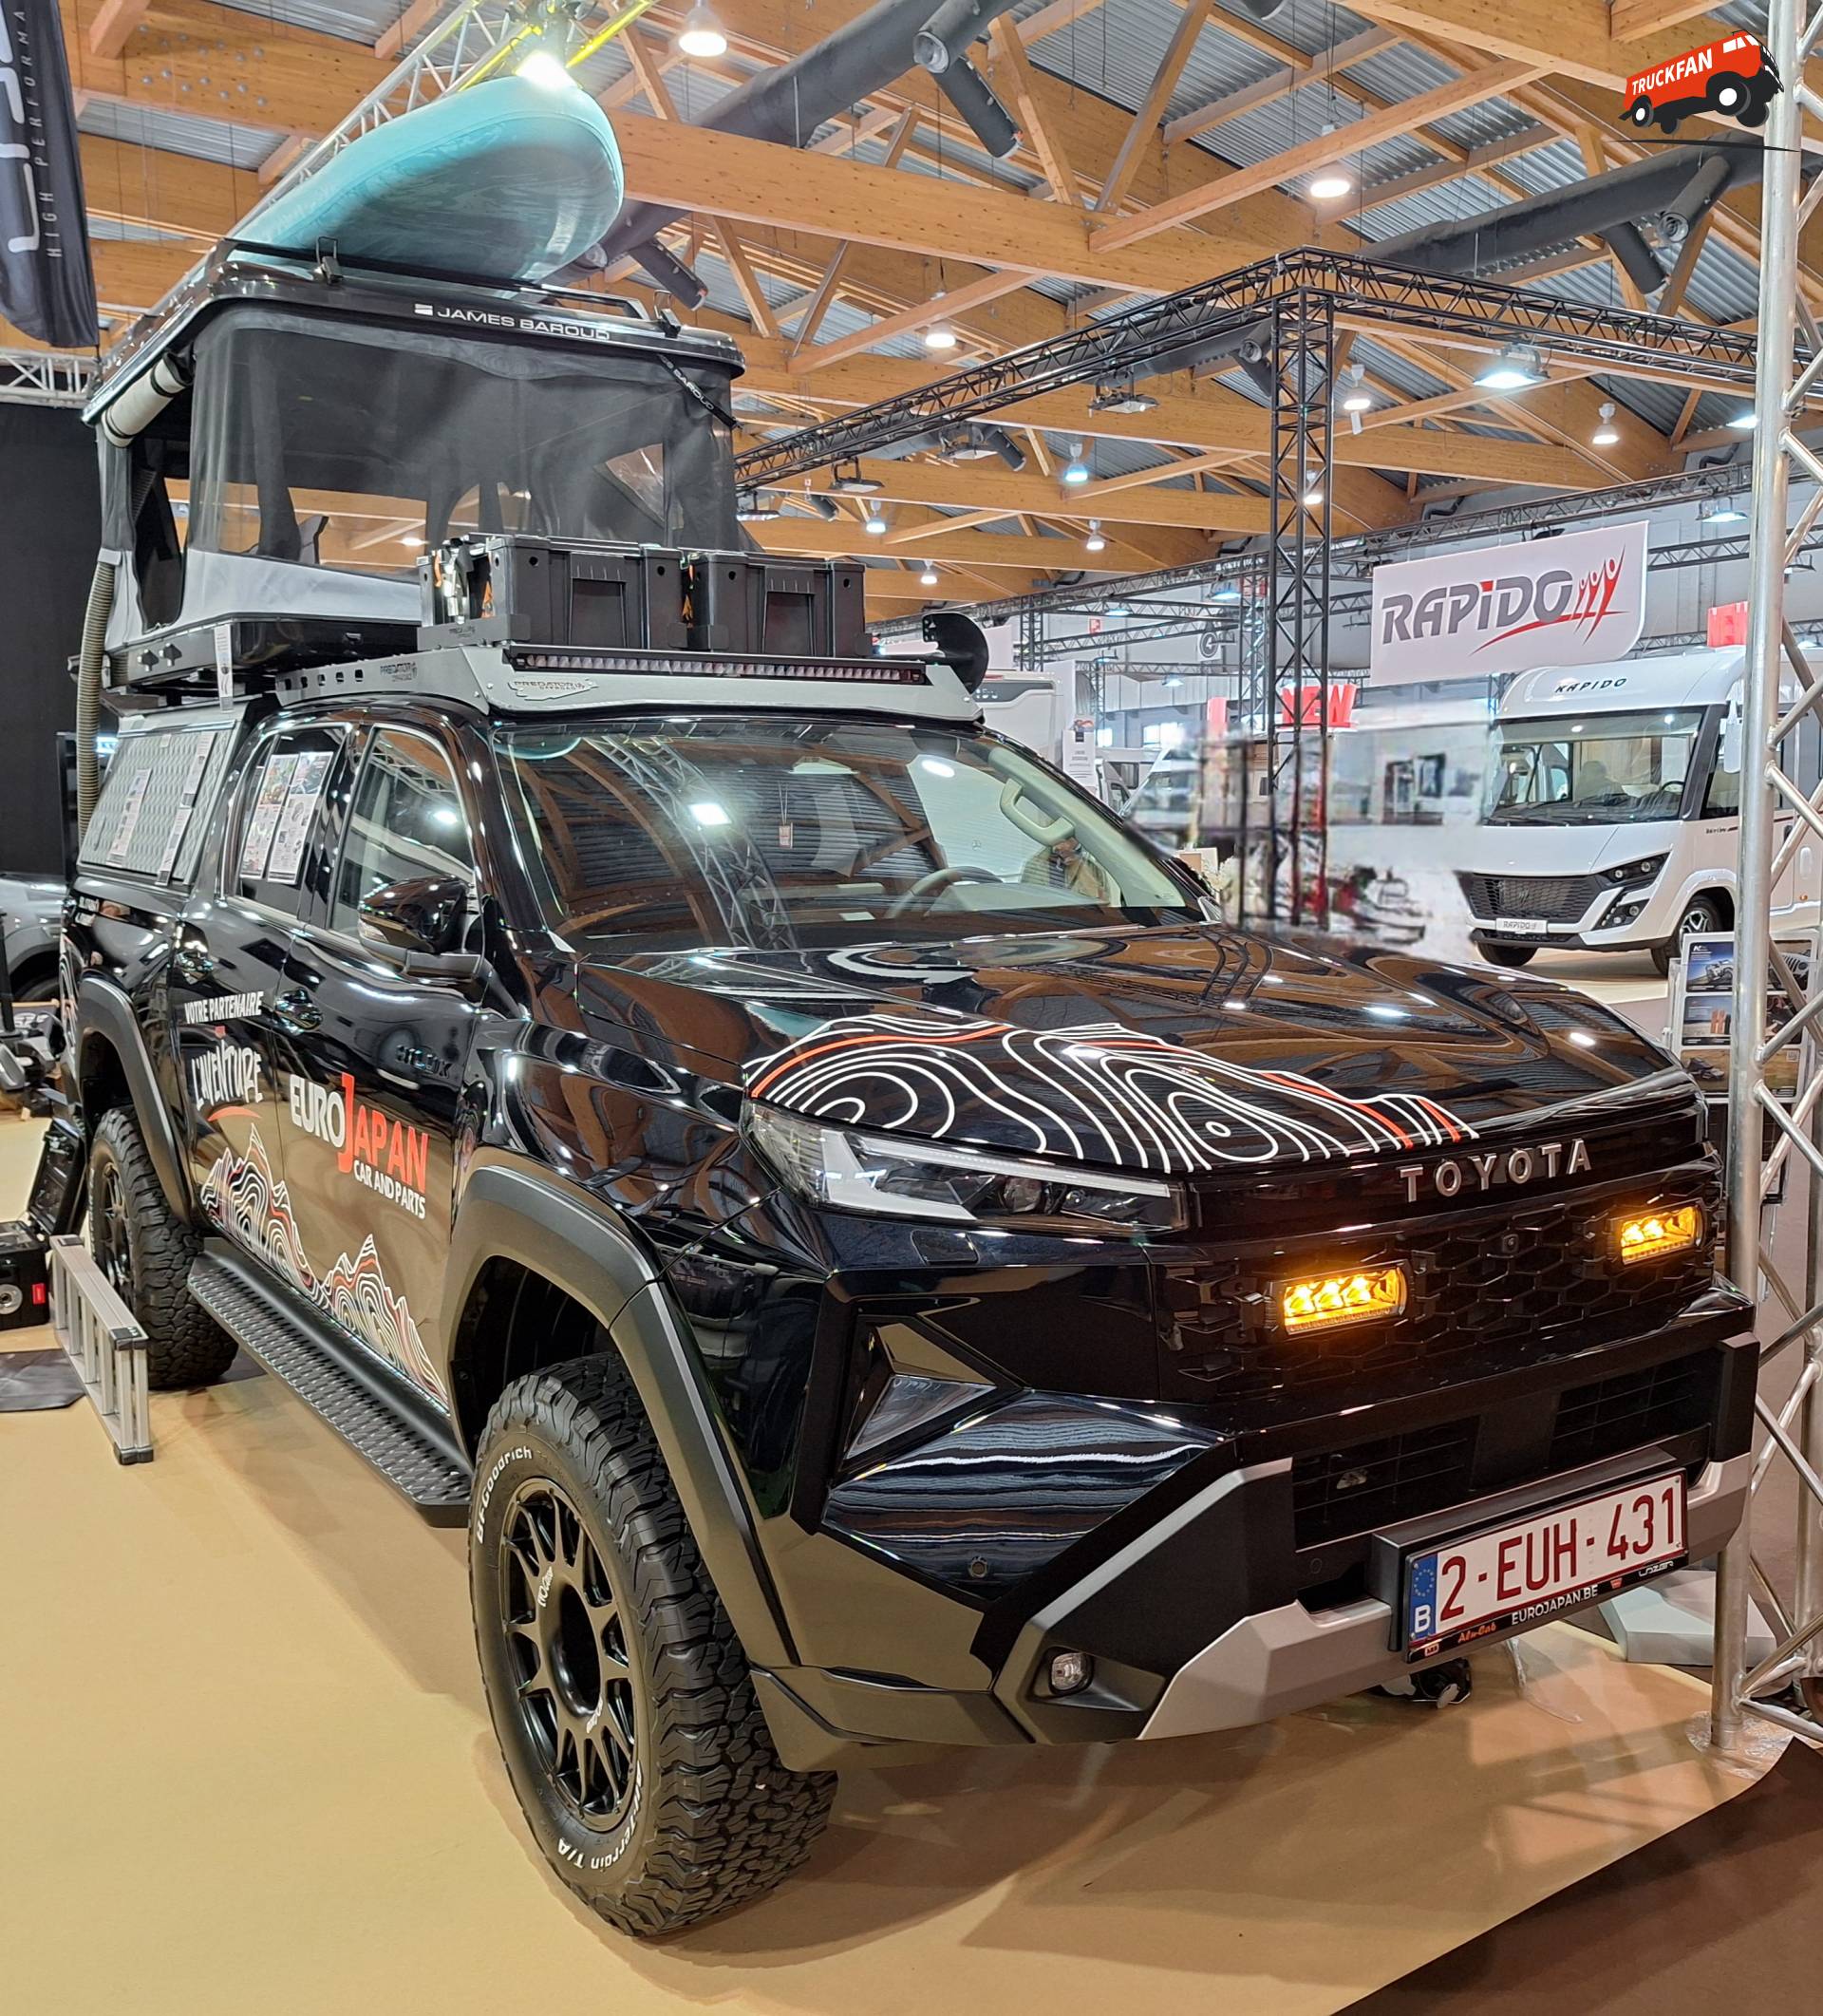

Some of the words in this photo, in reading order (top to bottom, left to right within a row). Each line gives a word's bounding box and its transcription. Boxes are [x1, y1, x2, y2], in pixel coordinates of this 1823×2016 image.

[39, 191, 63, 258] HIGH
[437, 308, 516, 328] JAMES
[519, 319, 611, 341] BAROUD
[184, 999, 209, 1025] VOTRE
[209, 990, 264, 1022] PARTENAIRE
[290, 1071, 430, 1194] EUROJAPAN
[353, 1159, 374, 1188] CAR
[373, 1171, 395, 1199] AND
[394, 1181, 426, 1219] PARTS
[1398, 1138, 1592, 1203] TOYOTA
[476, 1444, 533, 1545] BFGoodrich
[1414, 1604, 1431, 1633] B
[1511, 1584, 1599, 1626] EUROJAPAN.BE
